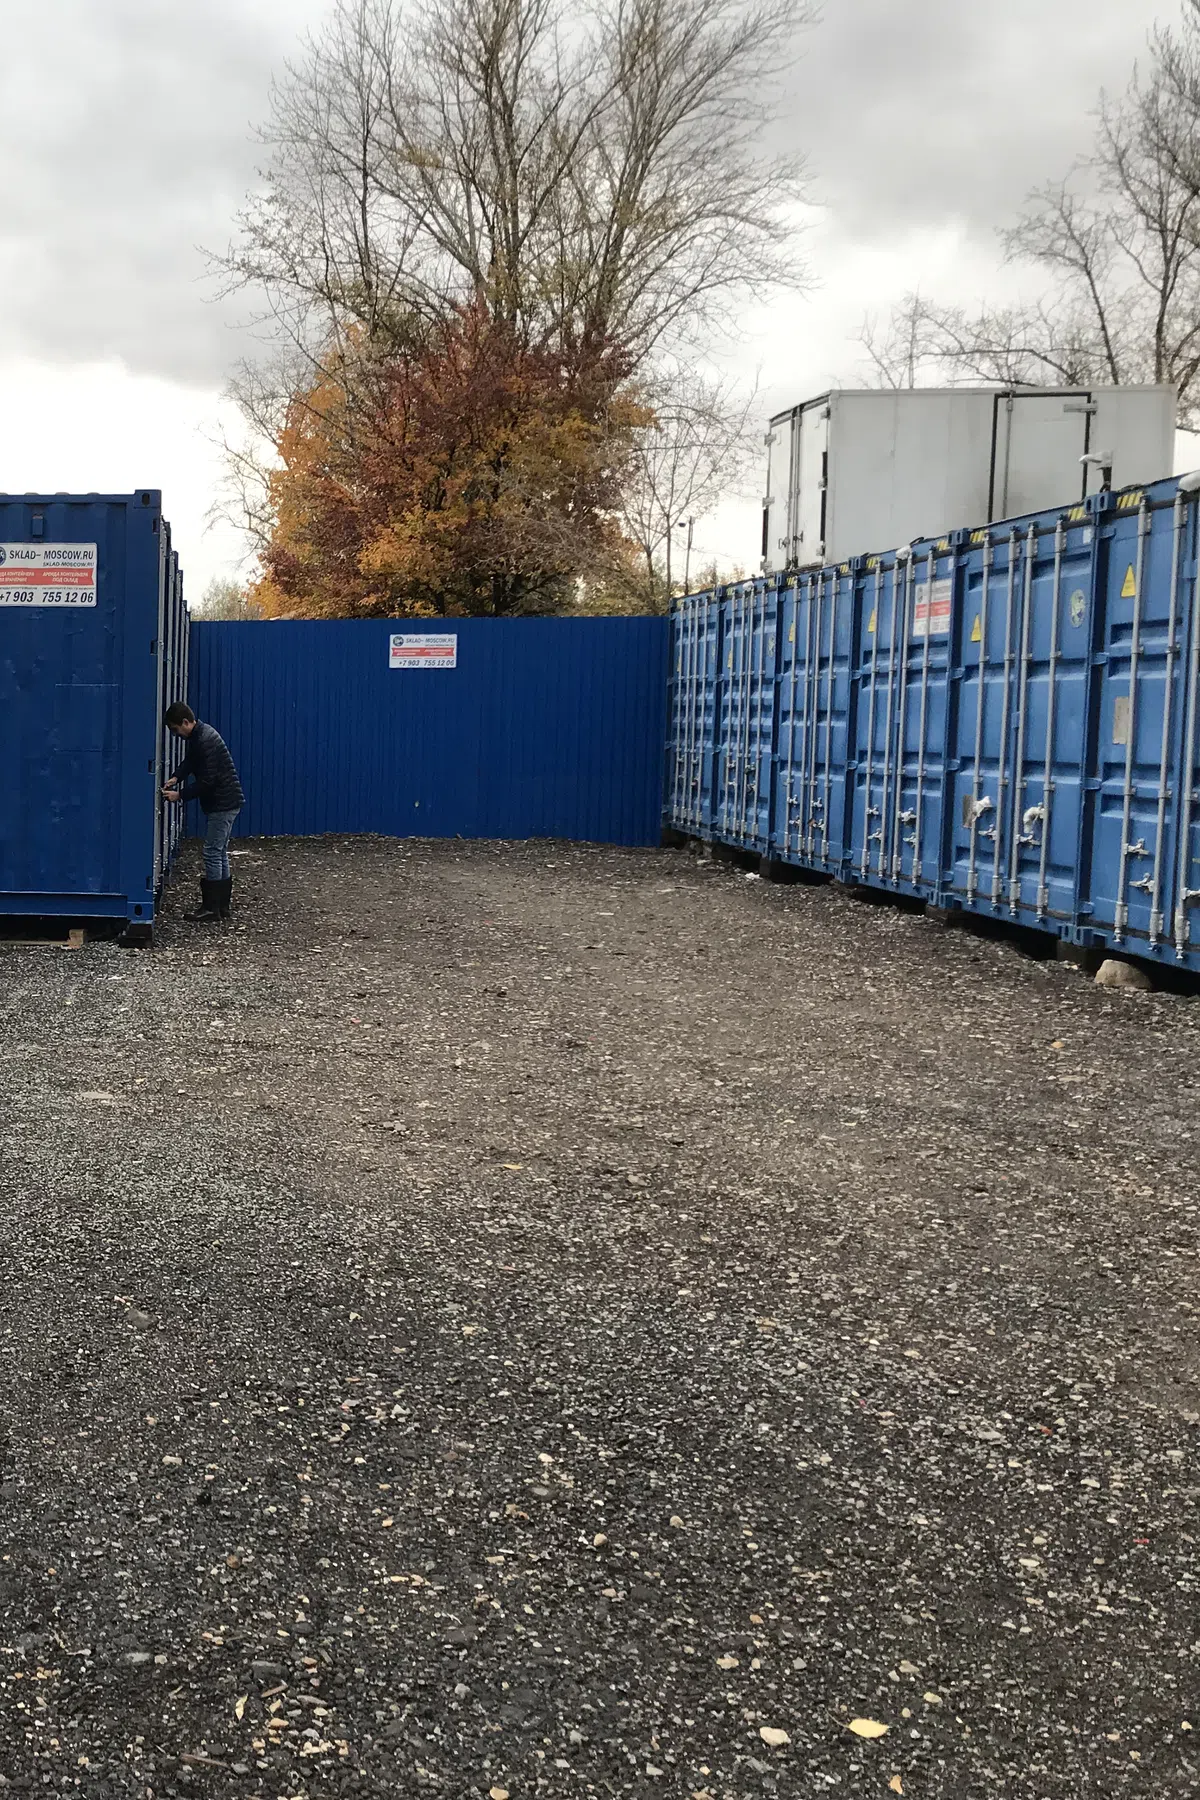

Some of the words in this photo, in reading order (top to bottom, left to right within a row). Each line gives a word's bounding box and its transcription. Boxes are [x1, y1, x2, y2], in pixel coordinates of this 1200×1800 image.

[9, 550, 41, 560] SKLAD-
[43, 550, 94, 560] MOSCOW.RU
[13, 591, 34, 603] 903
[42, 591, 62, 603] 755
[64, 592, 78, 603] 12
[80, 592, 94, 603] 06
